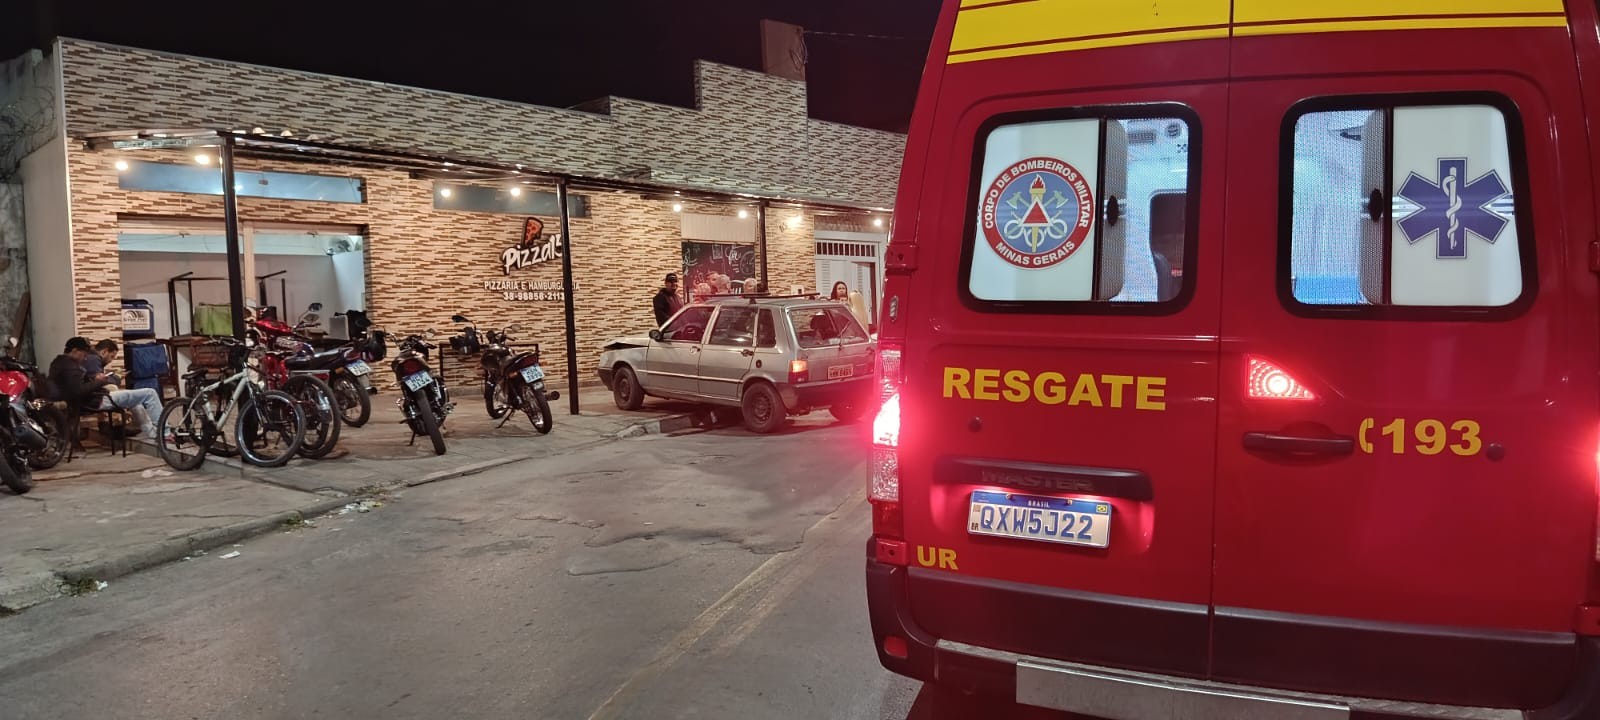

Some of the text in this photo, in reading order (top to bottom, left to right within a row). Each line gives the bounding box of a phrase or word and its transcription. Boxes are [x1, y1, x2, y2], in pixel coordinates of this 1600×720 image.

[985, 160, 1091, 229] CORPO DE BOMBEIROS MILITAR
[995, 241, 1075, 265] MINAS GERAIS
[484, 281, 519, 290] PIZZARIA
[521, 282, 526, 290] E
[943, 367, 1167, 410] RESGATE
[1382, 418, 1482, 456] 193
[982, 471, 1094, 492] MASTER
[1028, 500, 1051, 508] BRASIL
[980, 506, 1093, 540] QXW5J22
[917, 546, 959, 570] UR
